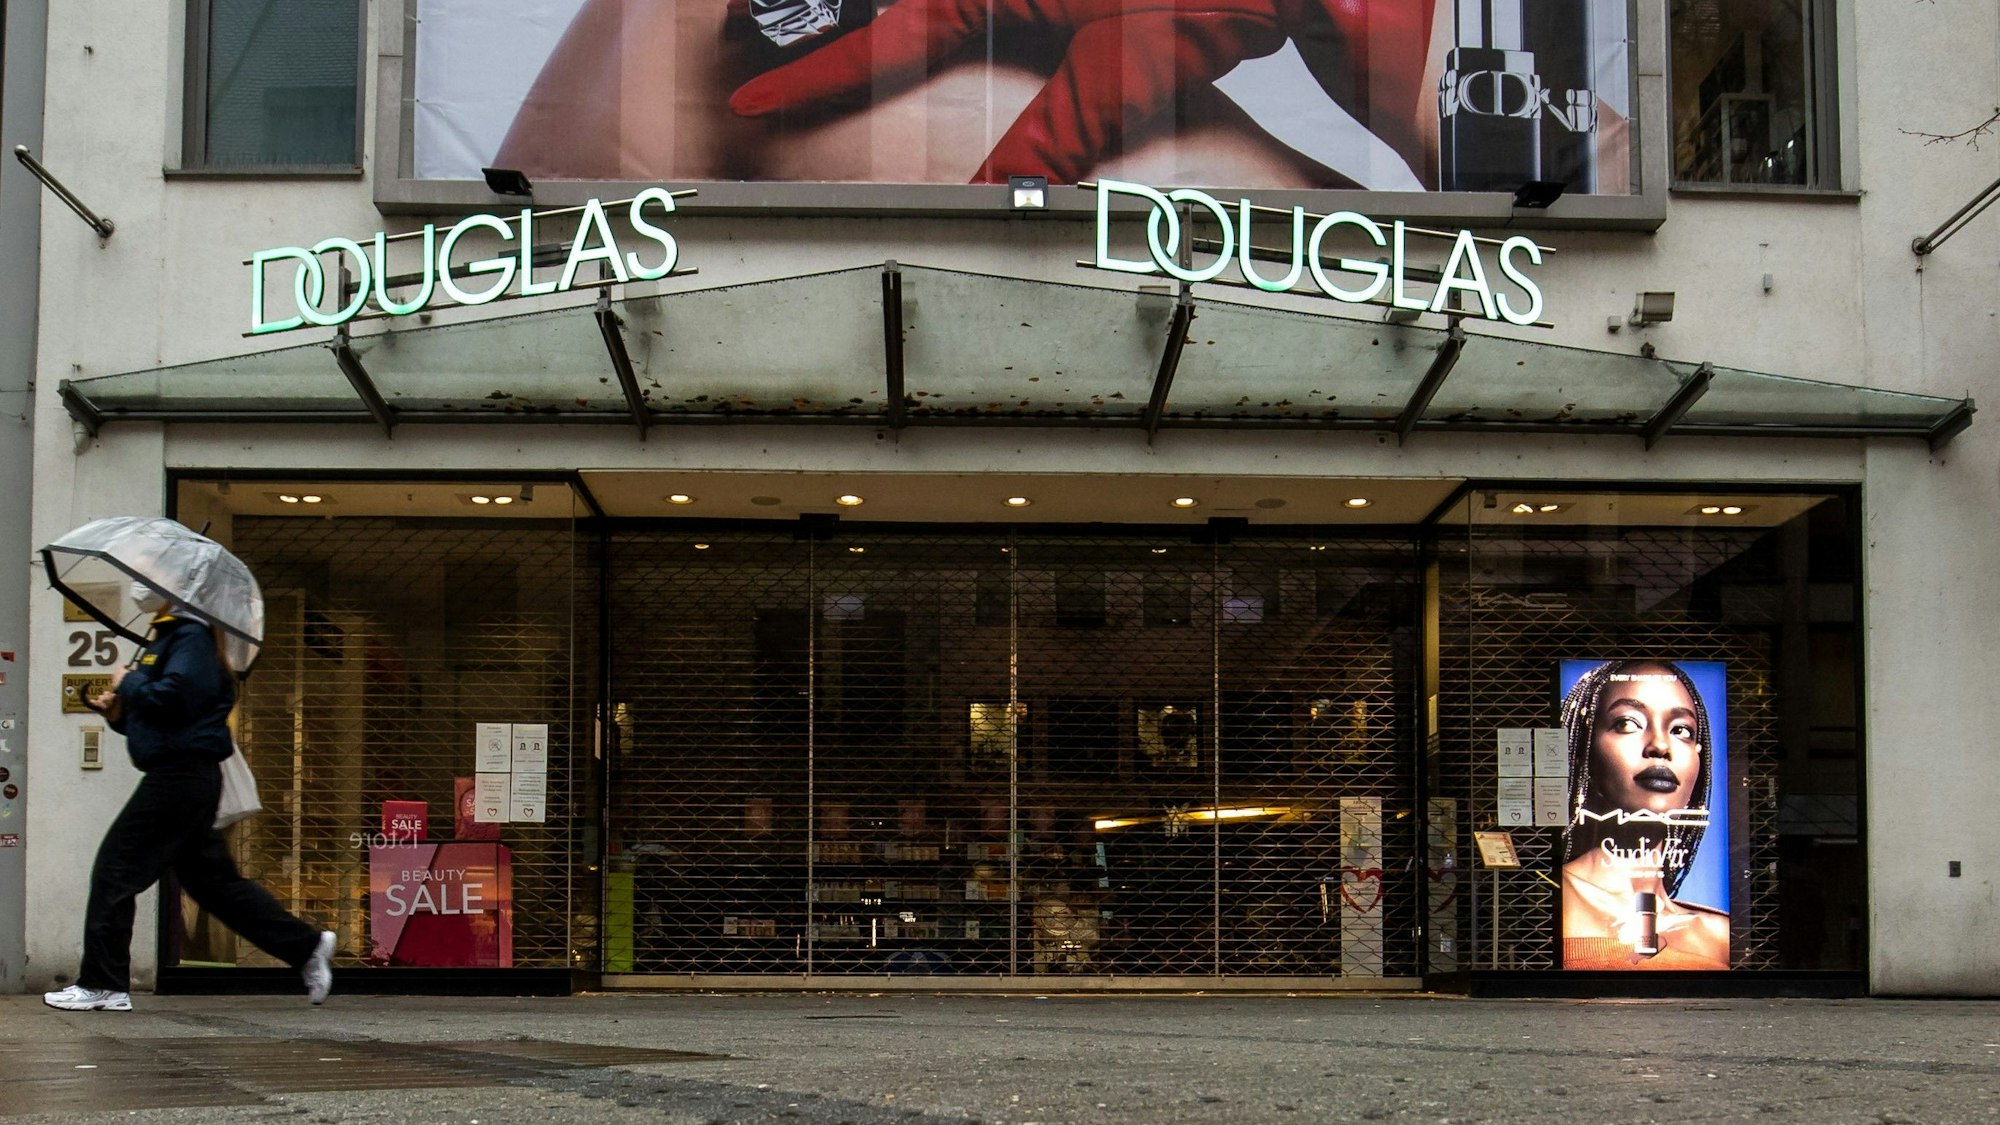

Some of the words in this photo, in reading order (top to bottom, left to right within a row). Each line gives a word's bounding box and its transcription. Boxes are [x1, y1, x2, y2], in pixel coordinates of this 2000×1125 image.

[252, 187, 678, 334] DOUGLAS
[1096, 178, 1543, 326] DOUGLAS
[68, 630, 118, 667] 25
[391, 819, 423, 830] SALE
[401, 869, 466, 882] BEAUTY
[385, 883, 484, 916] SALE
